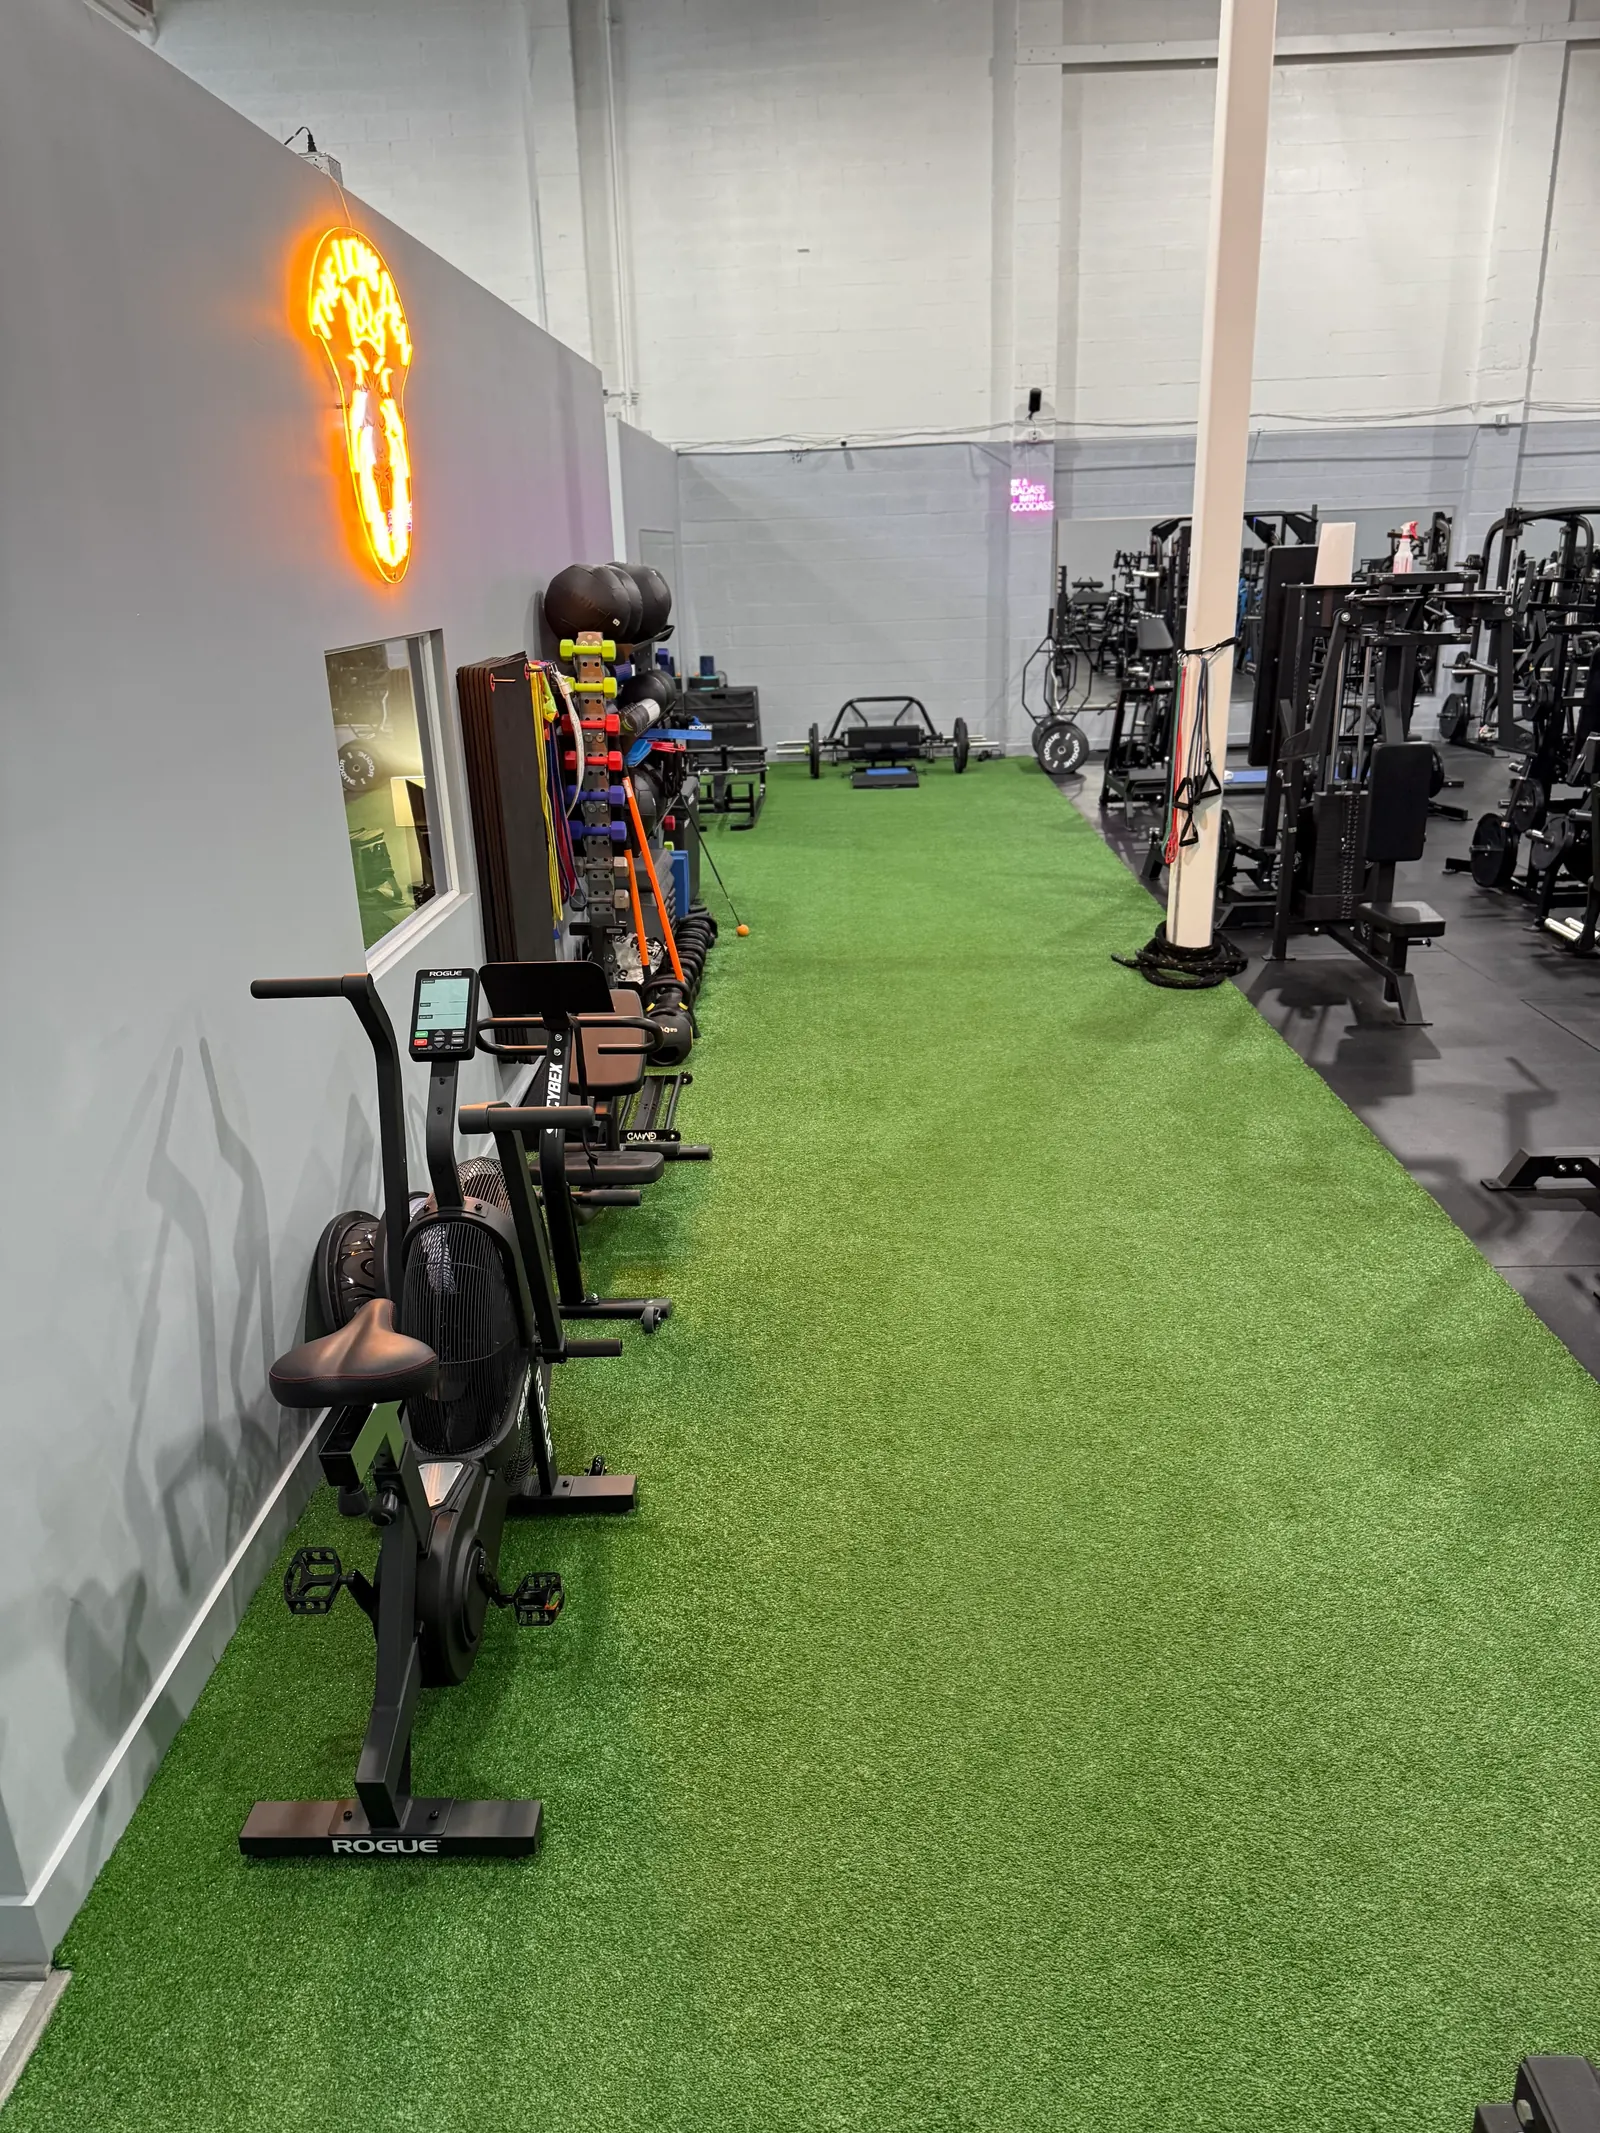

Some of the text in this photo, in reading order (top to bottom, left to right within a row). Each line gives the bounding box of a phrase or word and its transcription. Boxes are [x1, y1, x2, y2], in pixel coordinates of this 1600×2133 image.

[1011, 485, 1046, 496] BADASS
[1010, 501, 1055, 512] GOODASS
[1043, 732, 1060, 761] ROGUE
[1063, 739, 1080, 768] ROGUE
[546, 1062, 563, 1107] CYBEX
[332, 1840, 439, 1853] ROGUE
